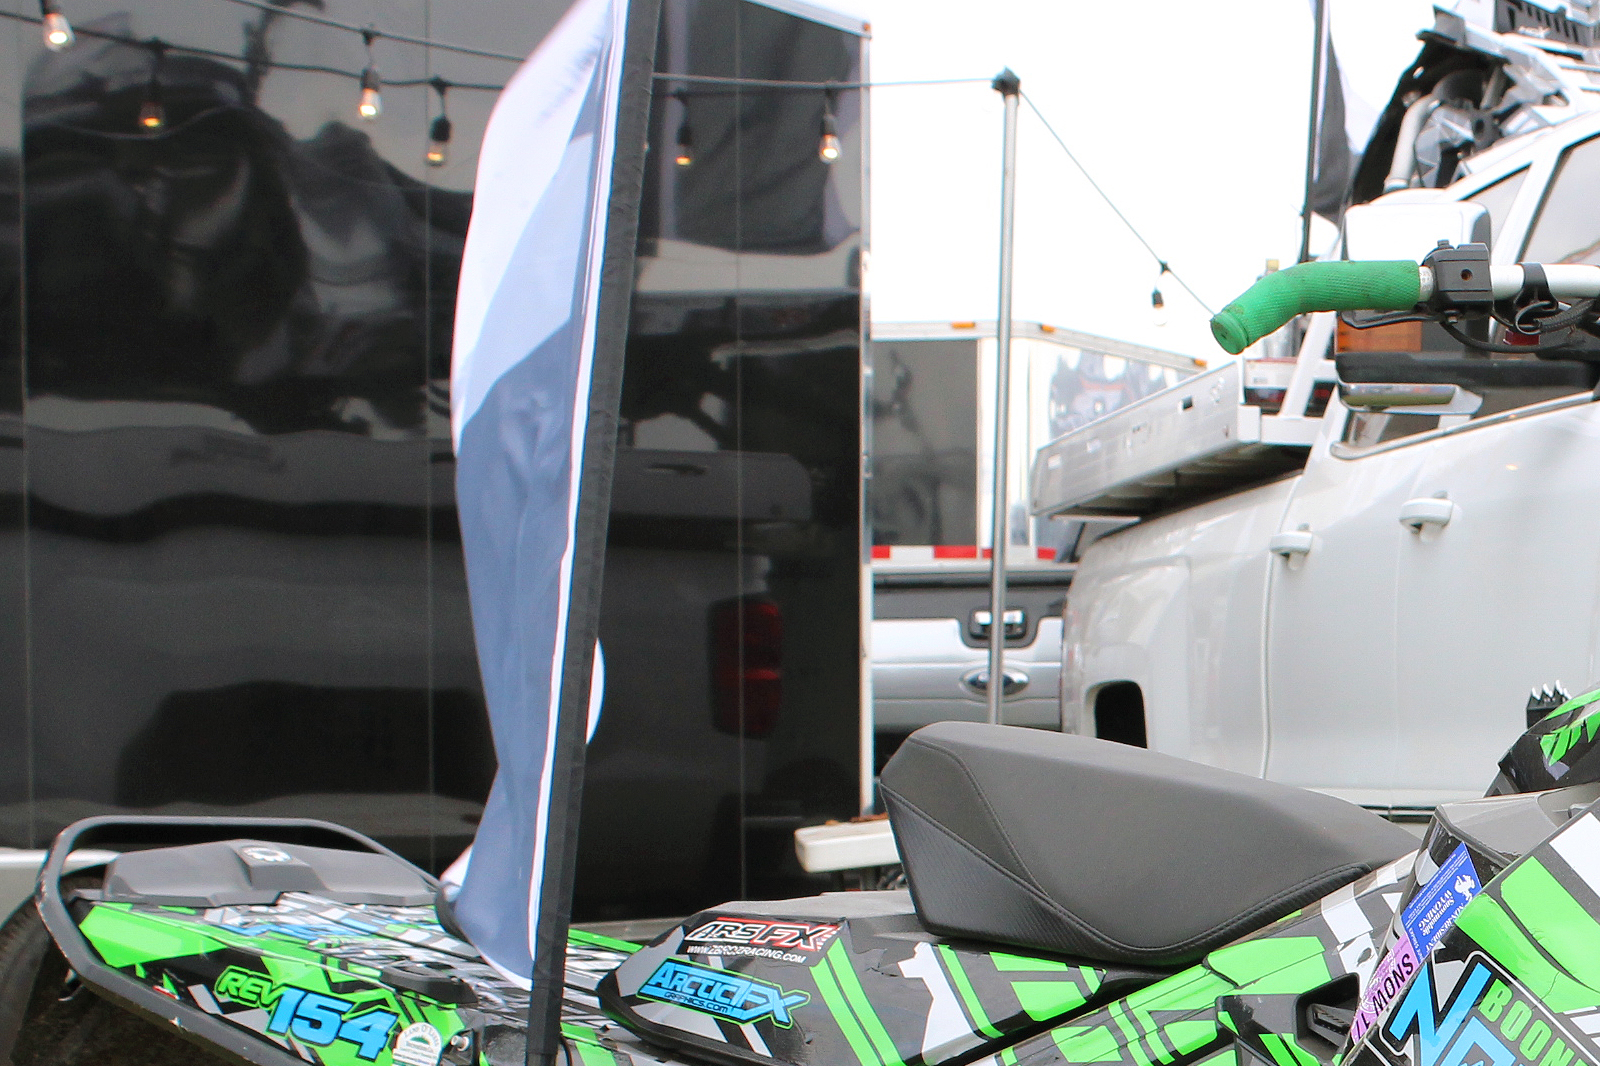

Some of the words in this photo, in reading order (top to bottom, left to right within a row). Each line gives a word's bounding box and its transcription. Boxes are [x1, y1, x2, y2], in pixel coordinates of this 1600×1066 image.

[1418, 890, 1452, 931] WYOMING
[217, 971, 285, 1007] REV
[267, 987, 399, 1062] 154
